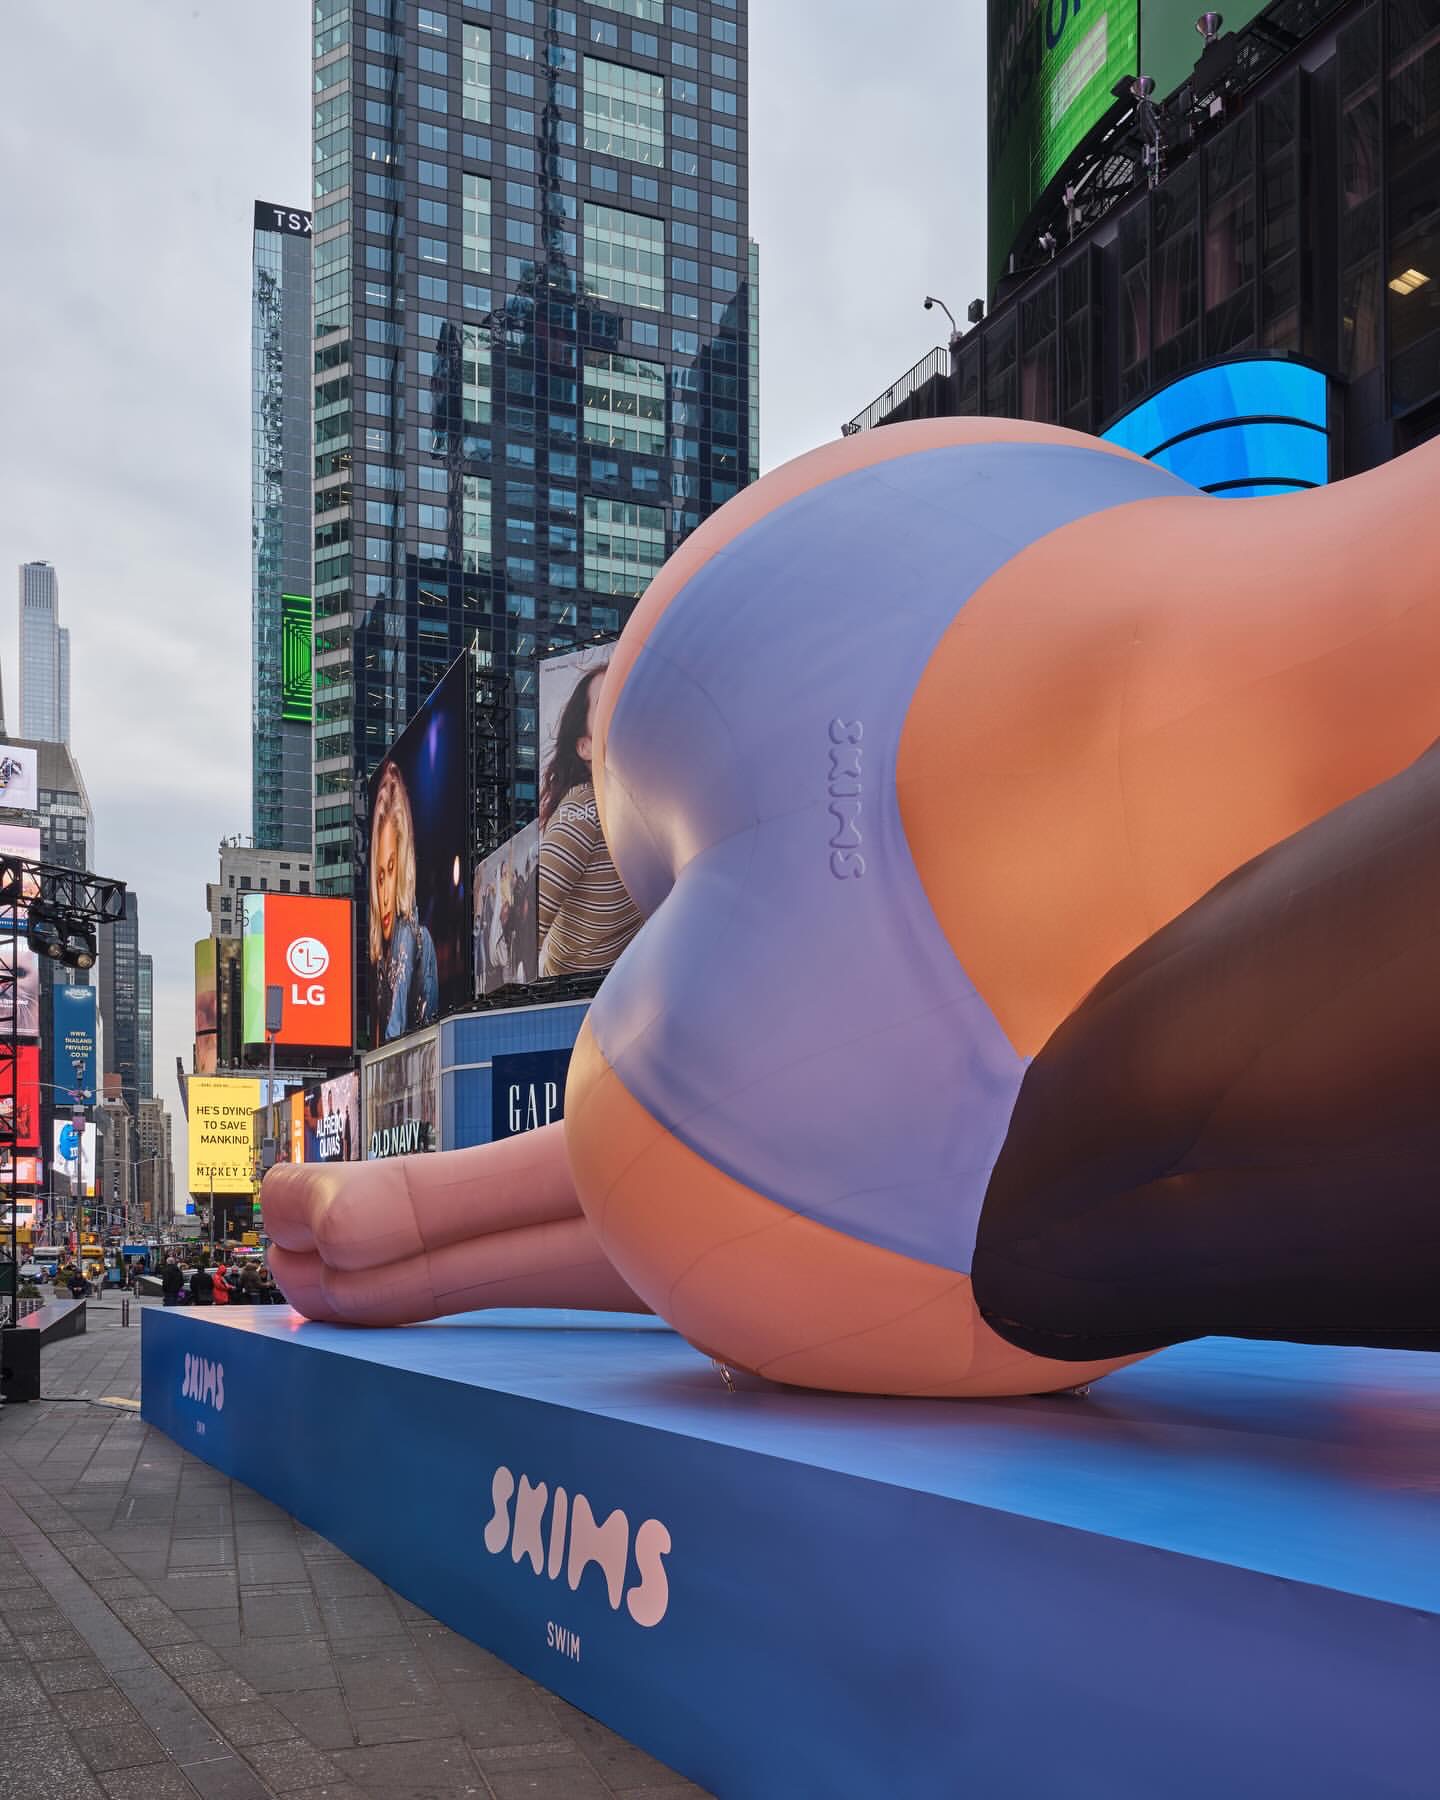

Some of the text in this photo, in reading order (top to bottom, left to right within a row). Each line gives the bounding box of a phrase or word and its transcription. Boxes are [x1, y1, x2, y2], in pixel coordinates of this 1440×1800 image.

[273, 209, 313, 233] TSX
[828, 717, 865, 881] SKIMS
[559, 801, 597, 824] Feels
[291, 983, 326, 1006] LG
[196, 1106, 253, 1116] HE'S DYING
[508, 1082, 557, 1132] GAP
[203, 1120, 247, 1130] TO SAVE
[316, 1112, 344, 1138] ALFREDO
[200, 1135, 250, 1145] MANKIND
[372, 1119, 420, 1157] OLD NAVY
[196, 1167, 239, 1177] MICKEY
[182, 1352, 225, 1412] SKIMS
[484, 1466, 672, 1627] SKIMS
[547, 1621, 580, 1663] SWIM
